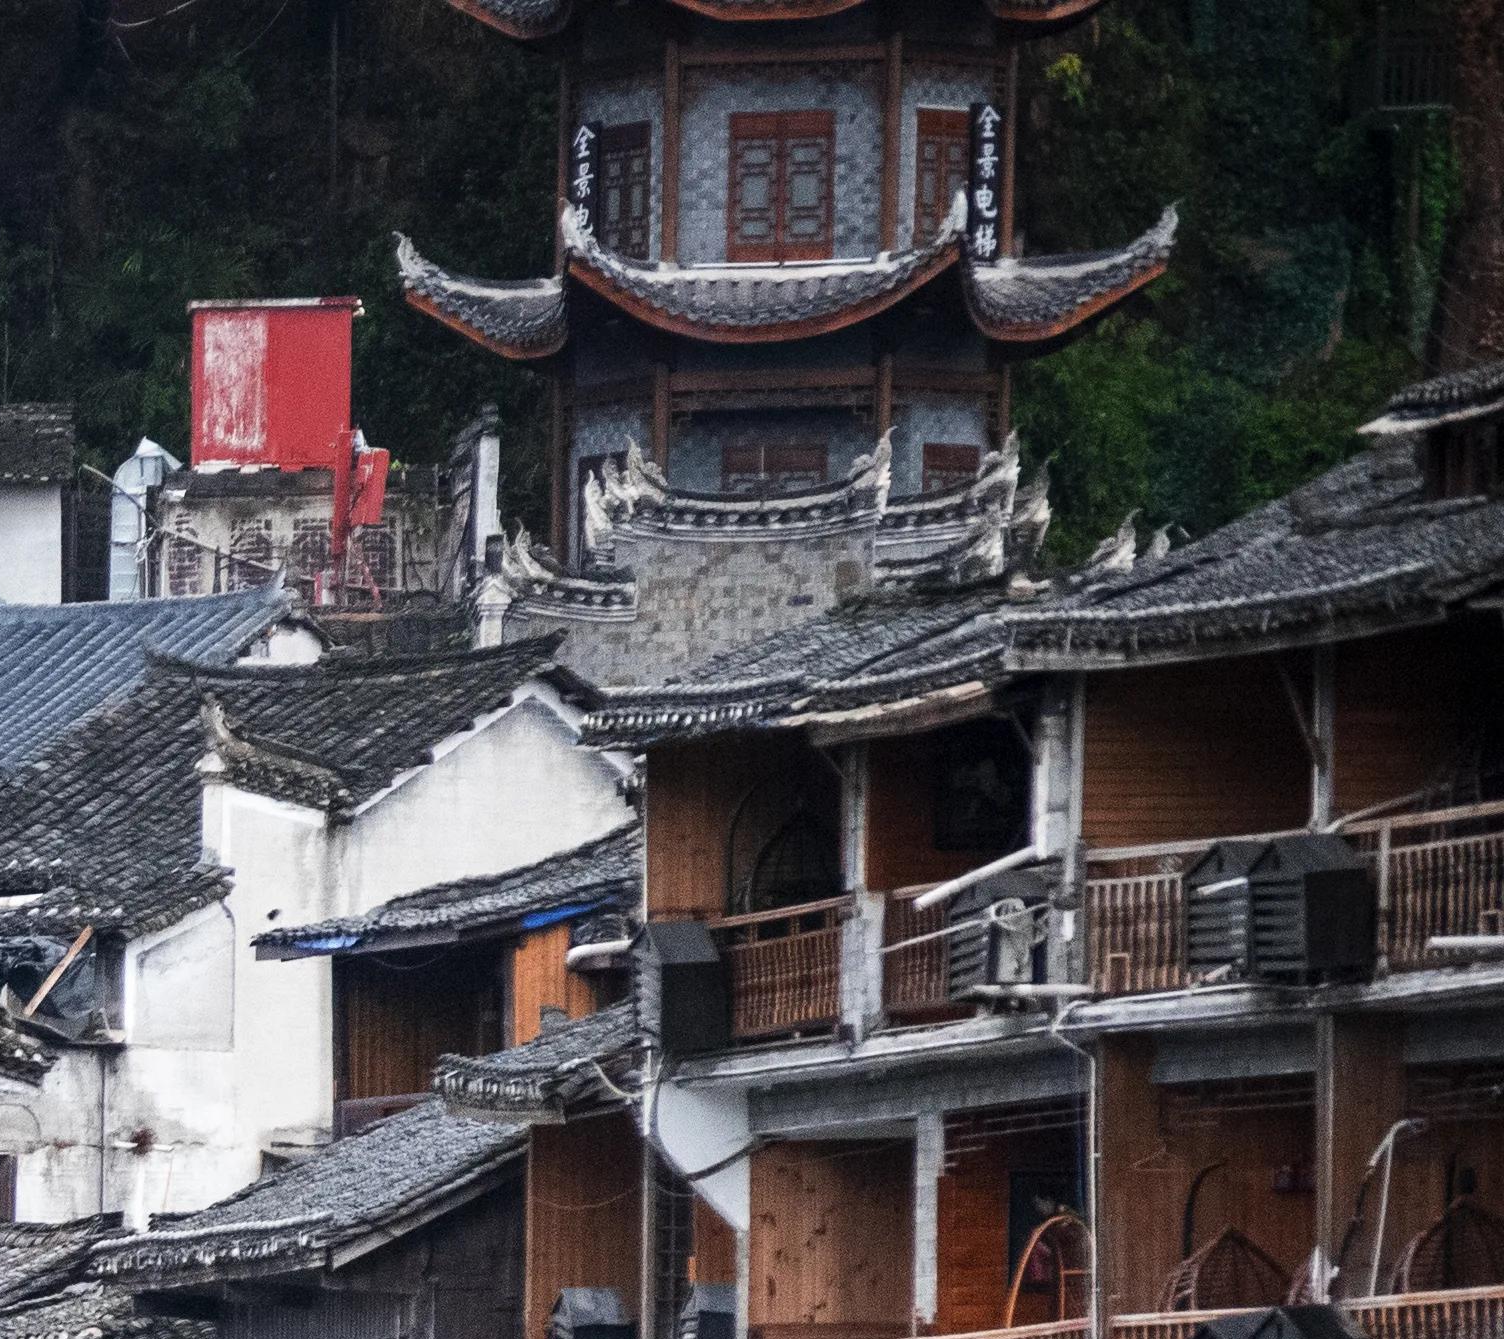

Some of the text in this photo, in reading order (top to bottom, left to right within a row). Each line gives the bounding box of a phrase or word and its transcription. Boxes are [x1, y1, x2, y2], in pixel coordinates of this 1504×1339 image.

[573, 125, 596, 234] 全景电
[976, 104, 1001, 258] 全景电梯
